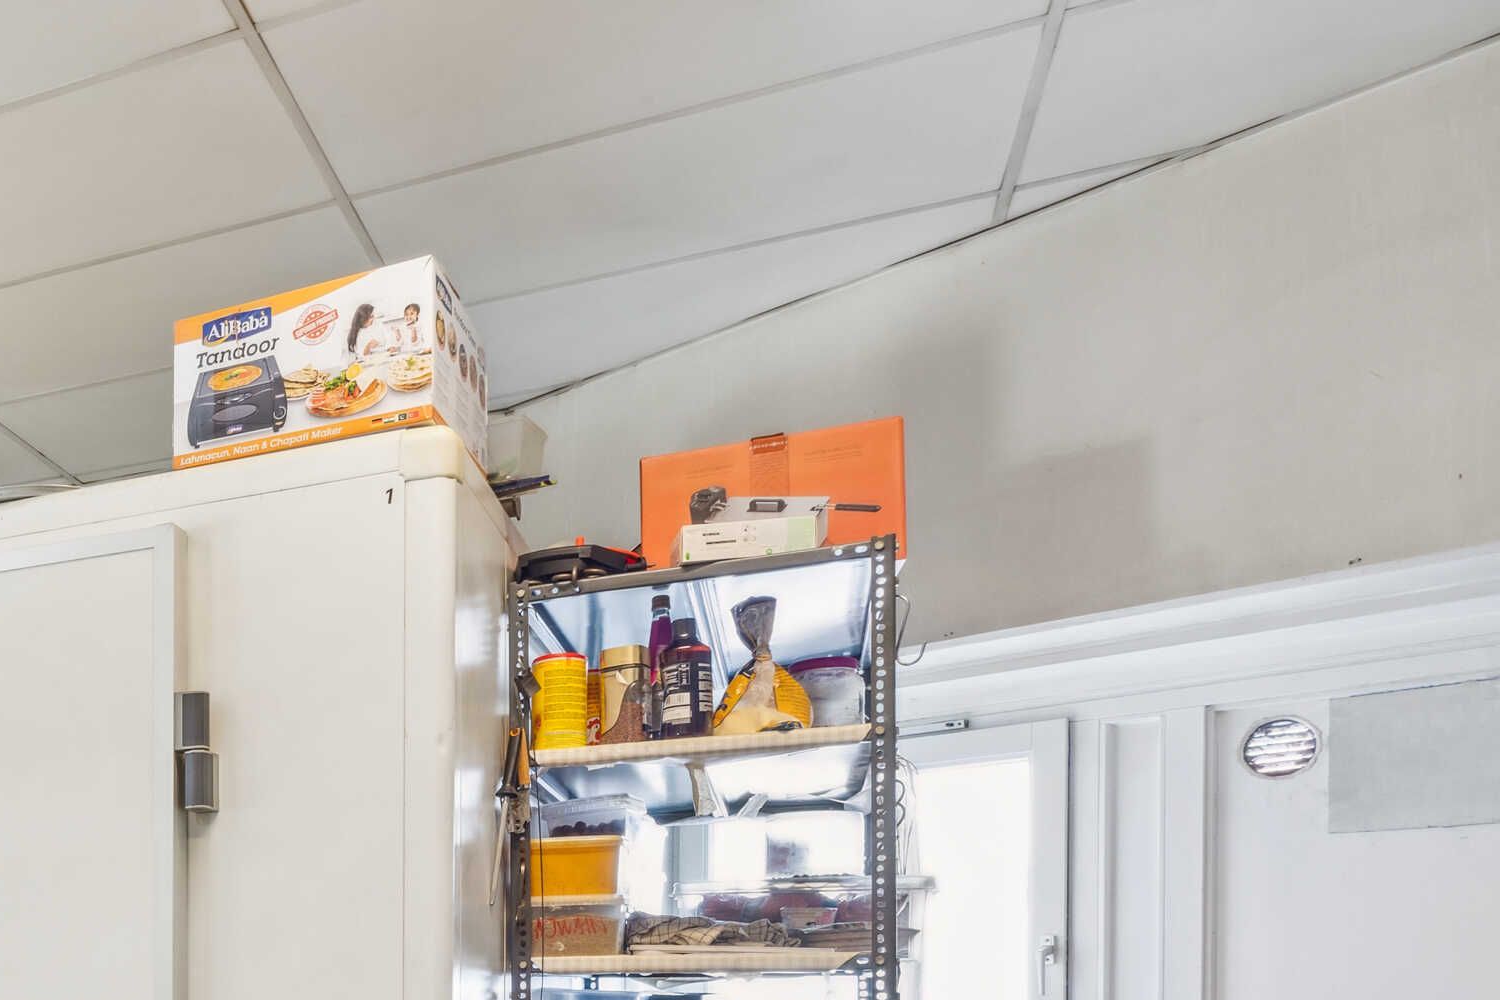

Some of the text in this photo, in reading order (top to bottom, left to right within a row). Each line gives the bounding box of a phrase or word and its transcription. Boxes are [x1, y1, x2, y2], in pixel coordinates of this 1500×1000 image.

[196, 337, 280, 369] Tandoor
[233, 443, 260, 455] Naan
[311, 426, 343, 440] Maker
[385, 488, 394, 505] 1
